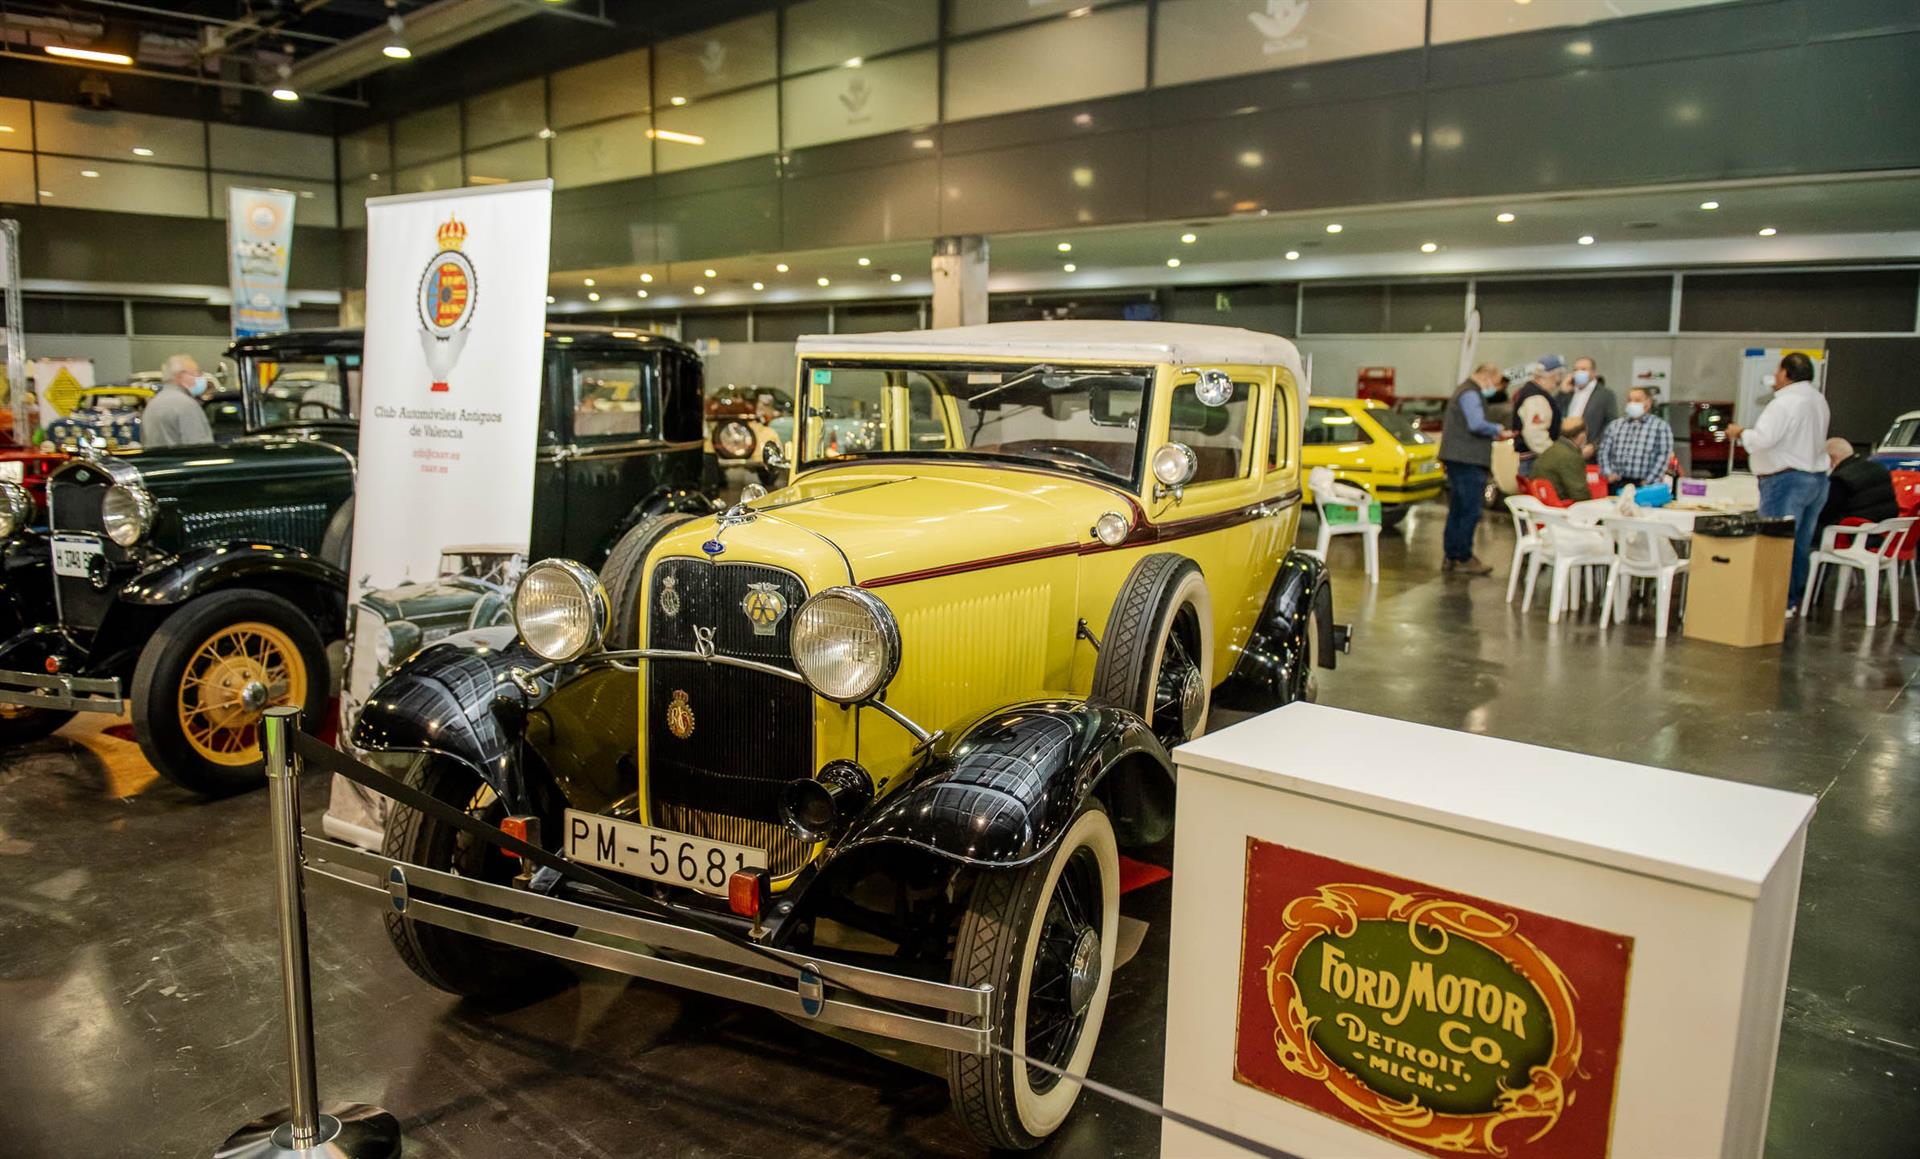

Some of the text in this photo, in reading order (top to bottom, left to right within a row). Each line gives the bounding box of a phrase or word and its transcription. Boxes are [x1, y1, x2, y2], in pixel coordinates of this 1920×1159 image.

[374, 406, 502, 425] Club Automóviles Antiguos
[409, 425, 463, 440] de Valencia
[1320, 941, 1528, 1040] FORD MOTOR
